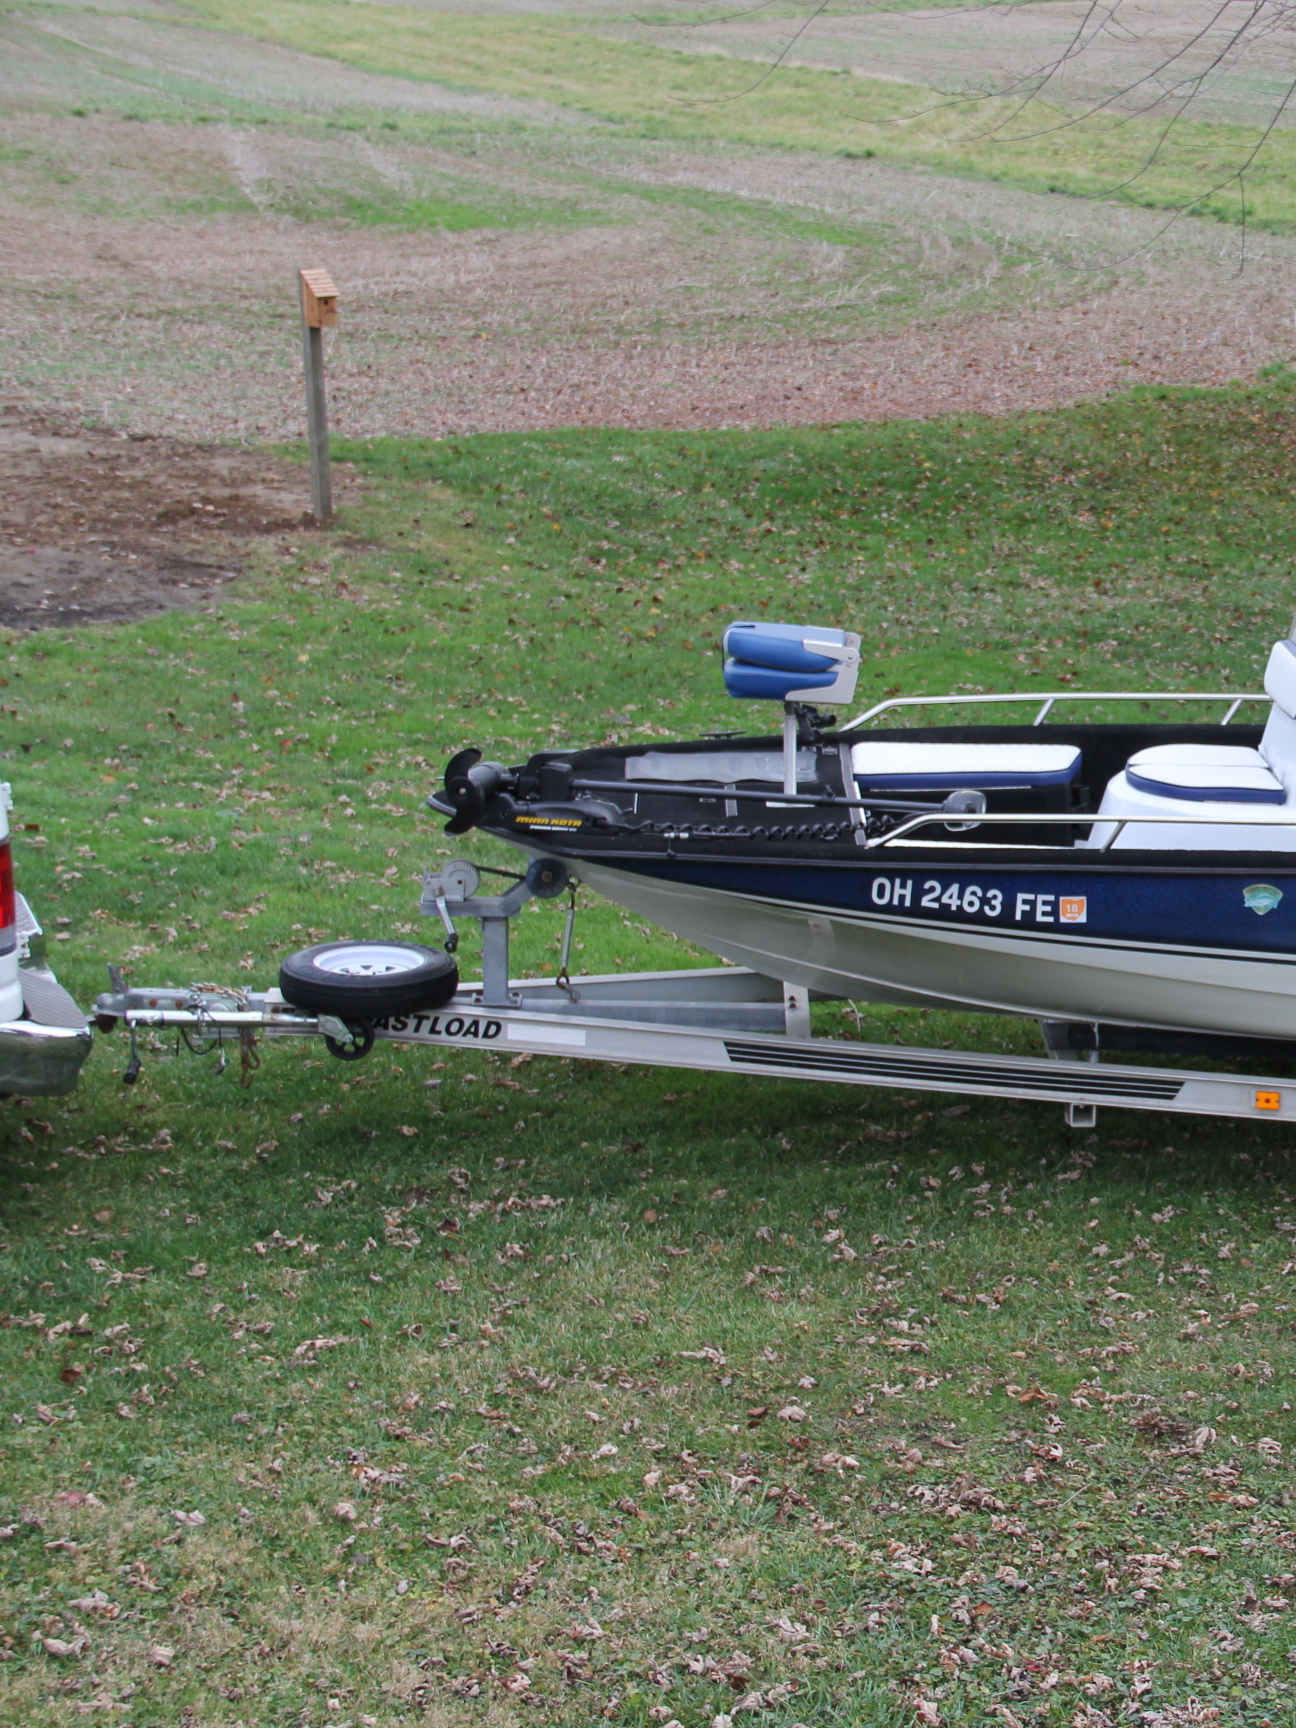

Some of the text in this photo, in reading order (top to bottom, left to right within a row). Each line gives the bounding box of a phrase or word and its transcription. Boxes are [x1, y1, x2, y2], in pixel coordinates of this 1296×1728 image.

[550, 818, 583, 827] KOTA
[871, 877, 1055, 923] OH 2463 FE
[1065, 903, 1079, 913] 18
[371, 1013, 503, 1040] ASTLOAD
